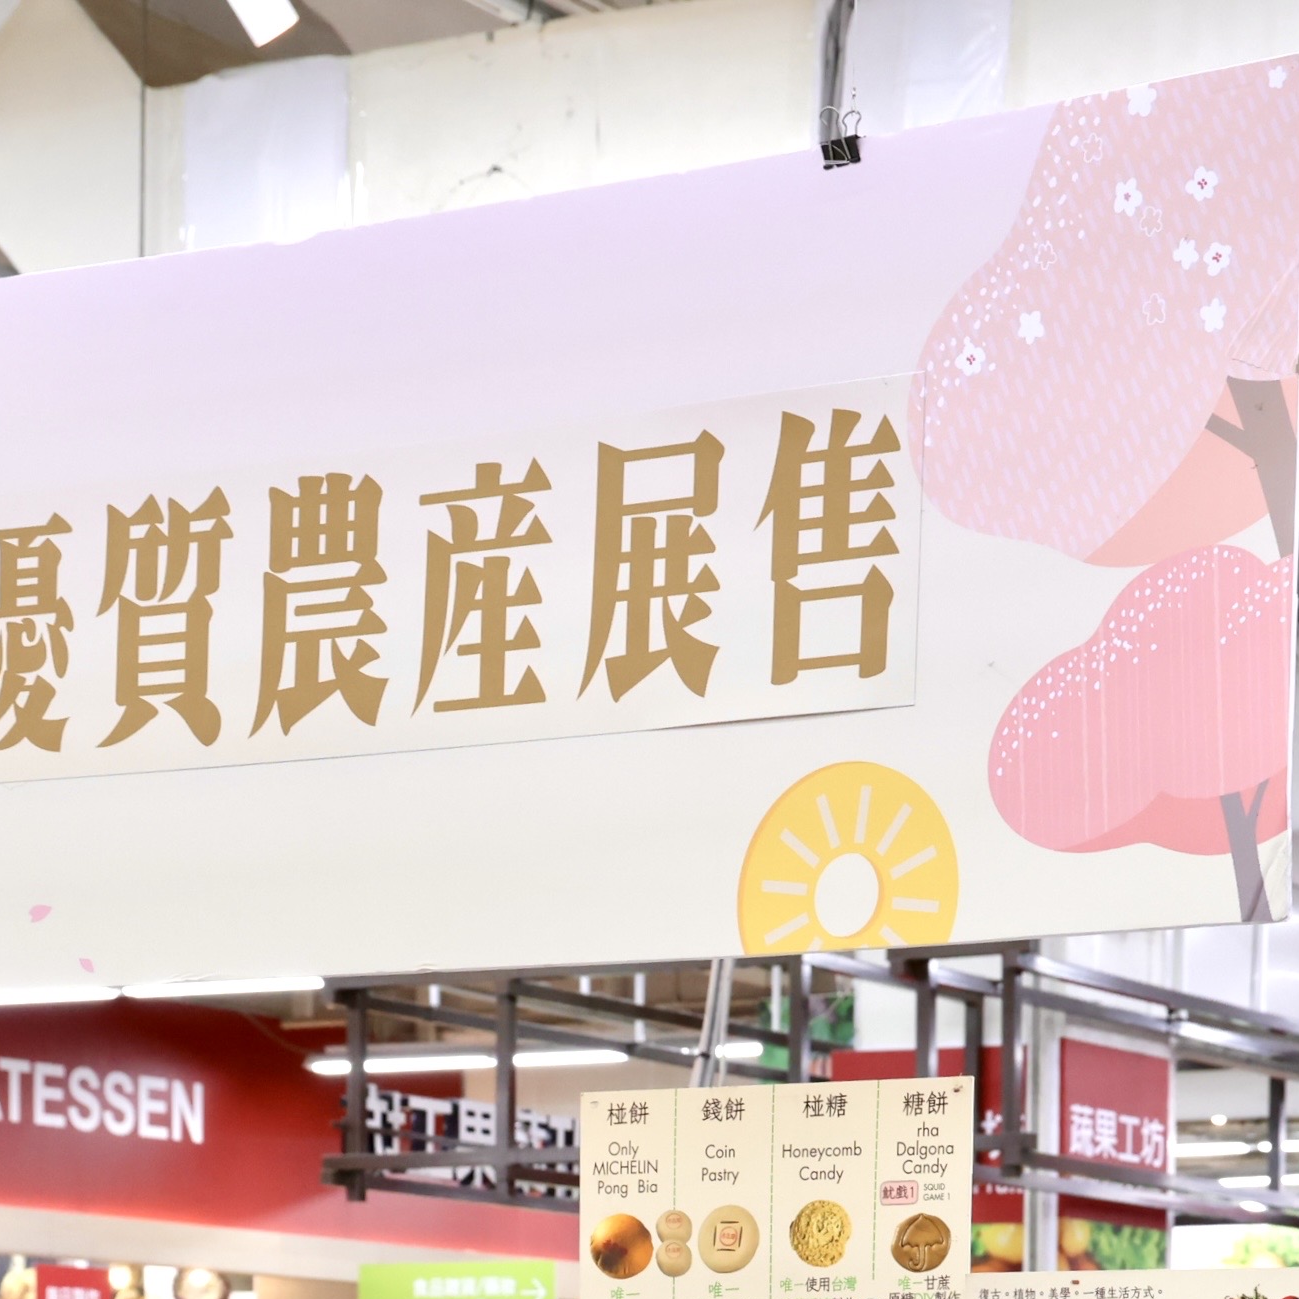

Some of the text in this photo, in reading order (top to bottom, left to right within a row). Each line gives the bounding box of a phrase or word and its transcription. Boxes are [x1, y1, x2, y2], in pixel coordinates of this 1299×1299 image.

[701, 1098, 746, 1122] 錢餅
[803, 1093, 847, 1119] 椪糖
[902, 1091, 949, 1117] 糖餅
[606, 1101, 650, 1126] 椪餅
[917, 1122, 939, 1138] rha
[608, 1141, 639, 1158] Only
[705, 1144, 736, 1160] Coin
[782, 1141, 863, 1161] Honeycomb
[896, 1141, 954, 1160] Dalgona
[593, 1160, 658, 1176] MICHELIN
[701, 1167, 740, 1185] Pastry
[799, 1166, 845, 1183] Candy
[902, 1159, 948, 1177] Candy
[597, 1178, 658, 1197] Pong Bia
[708, 1281, 740, 1298] 唯一
[779, 1276, 857, 1293] 唯一使用台灣
